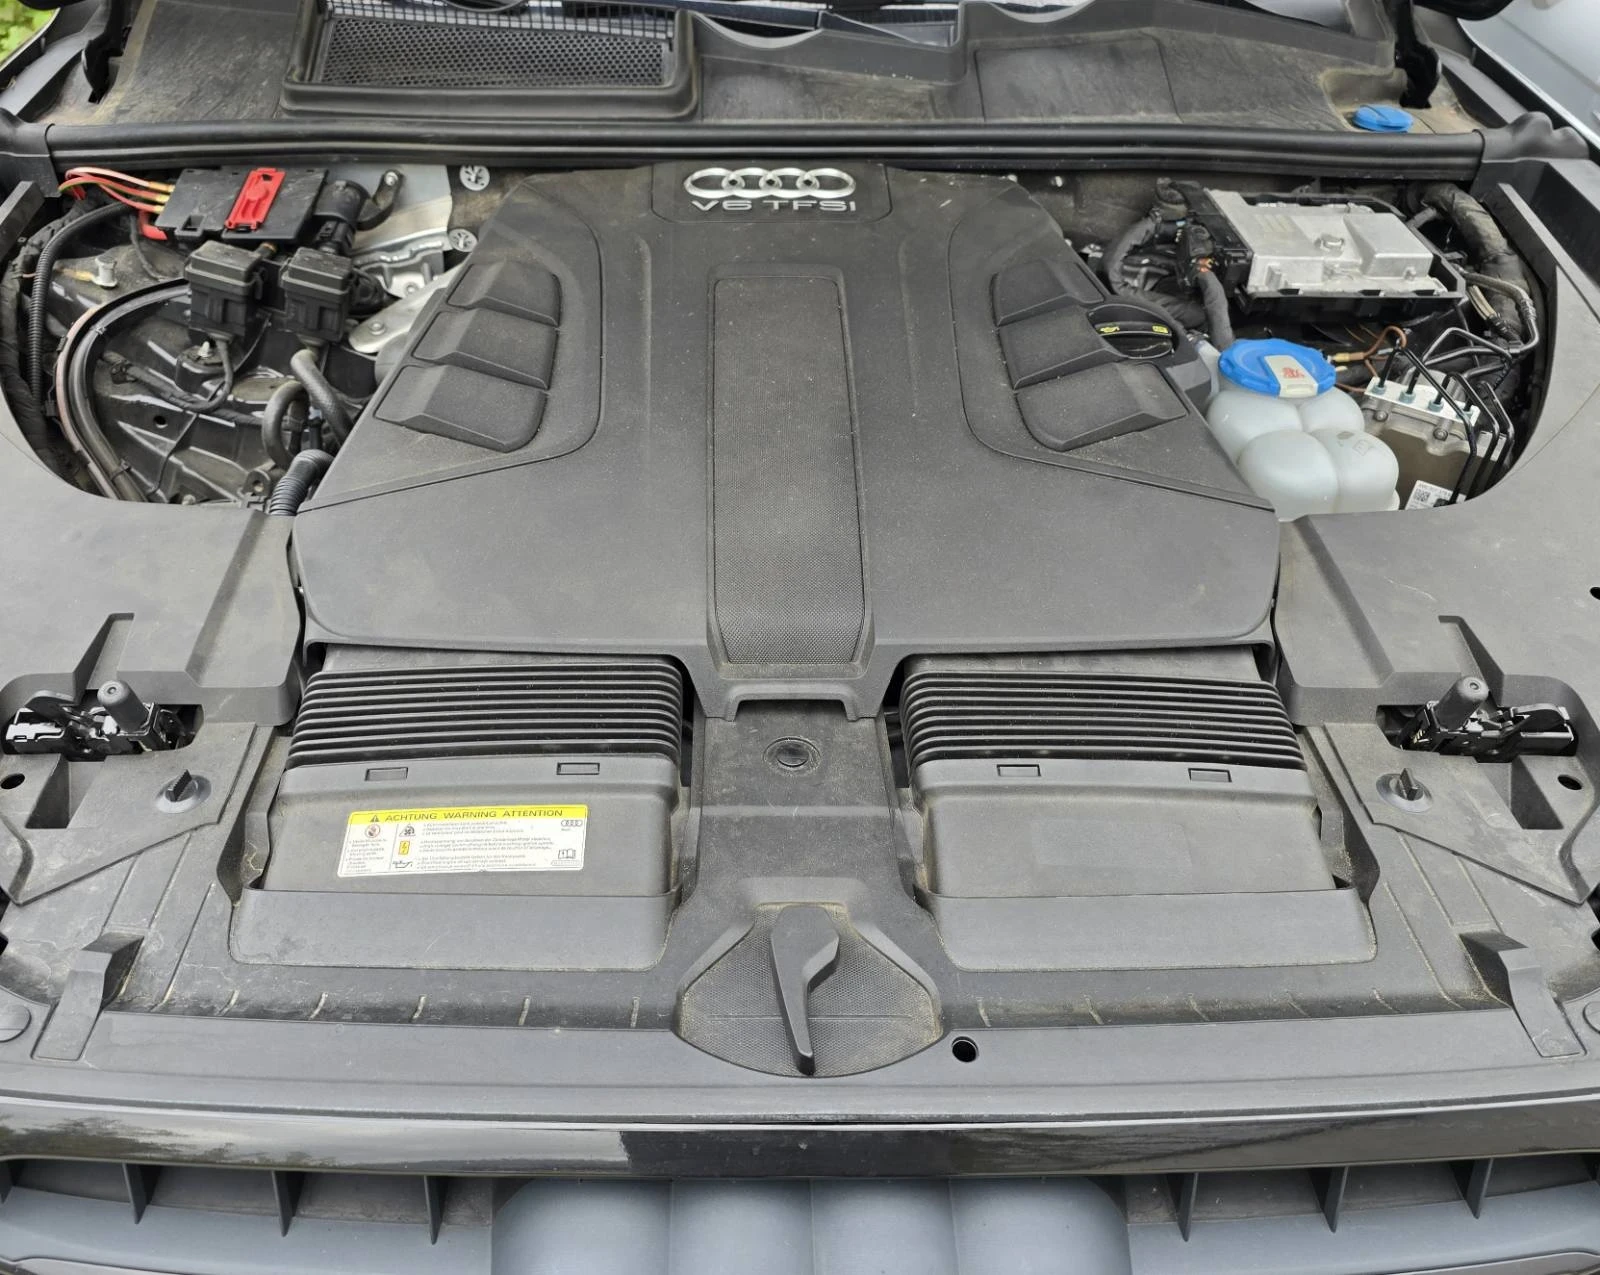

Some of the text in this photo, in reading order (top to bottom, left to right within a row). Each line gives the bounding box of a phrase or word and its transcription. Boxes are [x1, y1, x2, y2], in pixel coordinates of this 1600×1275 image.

[691, 200, 856, 211] V6 TFSI
[385, 813, 437, 822] ACHTUNG
[443, 811, 497, 819] WARNING
